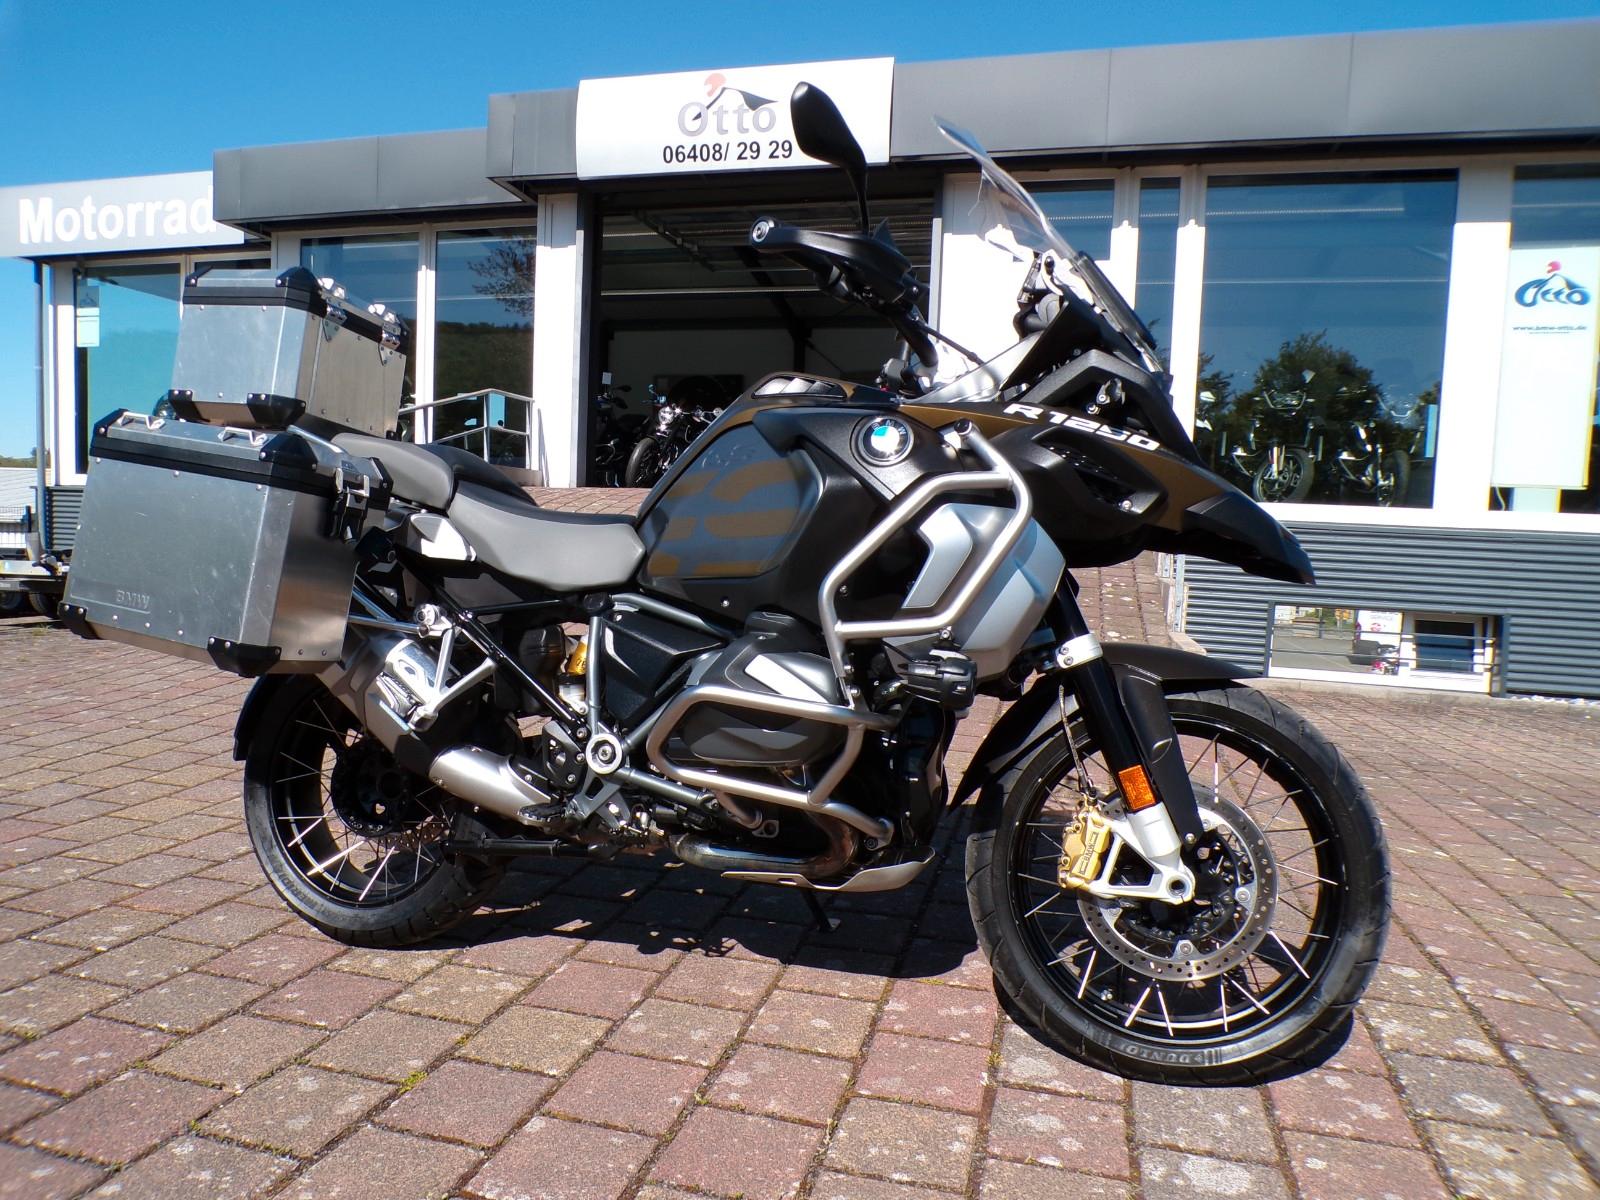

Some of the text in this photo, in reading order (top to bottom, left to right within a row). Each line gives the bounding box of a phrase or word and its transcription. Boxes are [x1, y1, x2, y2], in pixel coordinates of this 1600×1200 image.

[678, 102, 776, 137] Otto
[663, 140, 793, 164] 06408/ 29 29
[19, 186, 216, 244] Motorrad
[871, 419, 907, 435] BMW
[1003, 403, 1161, 451] R 1250
[116, 590, 150, 609] BMW
